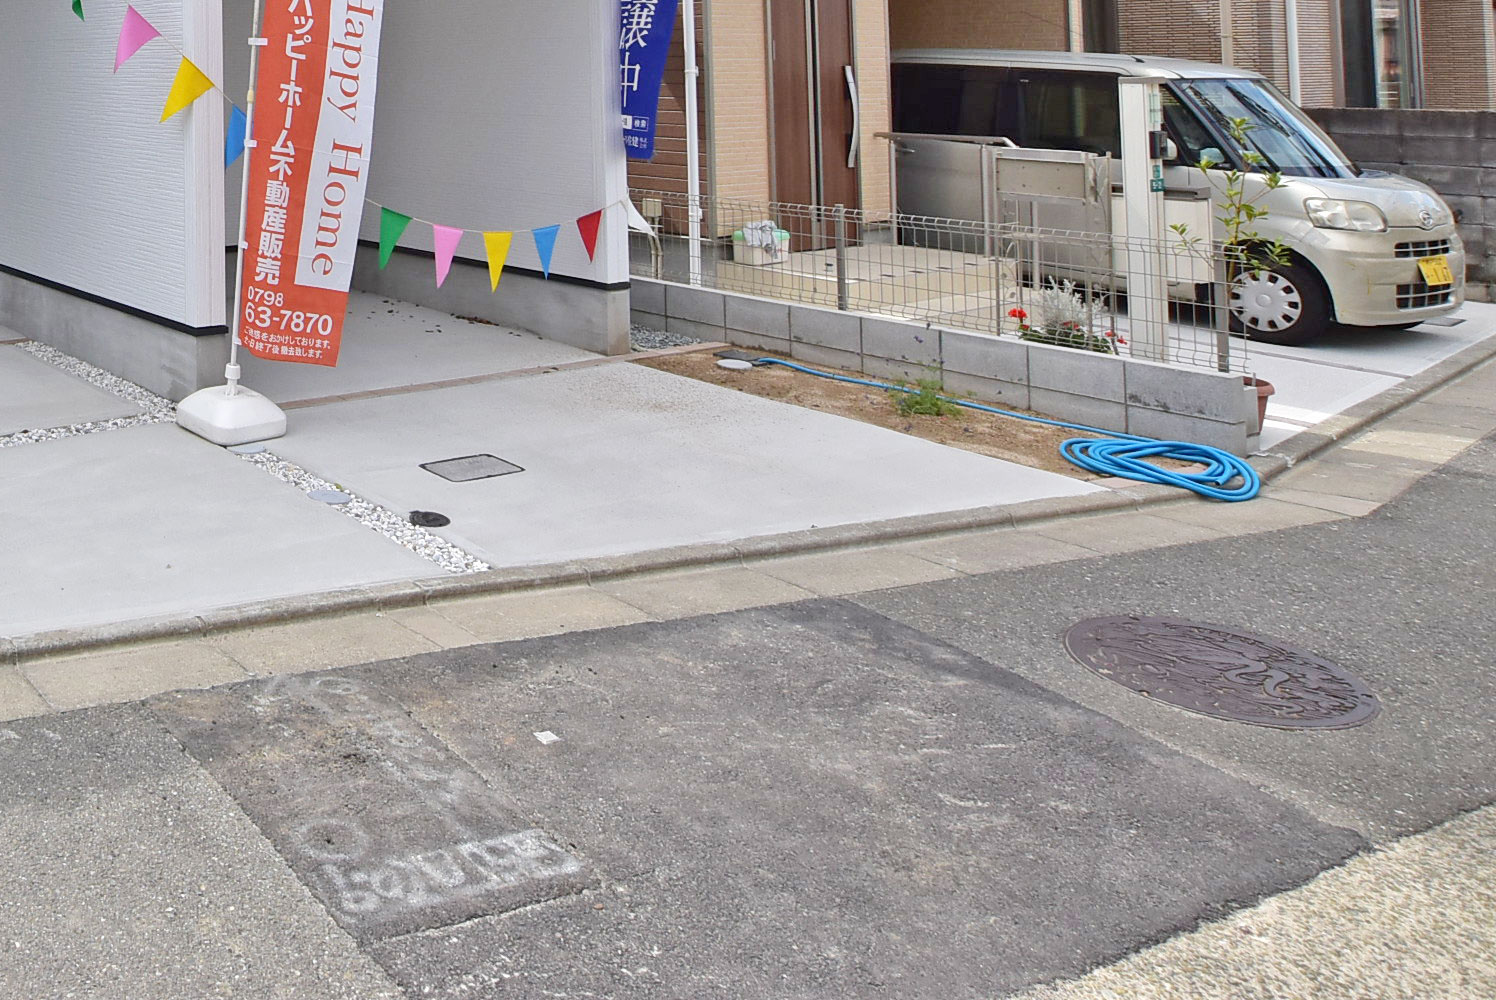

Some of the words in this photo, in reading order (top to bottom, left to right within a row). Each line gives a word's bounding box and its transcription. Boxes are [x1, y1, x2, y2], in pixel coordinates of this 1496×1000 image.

[310, 142, 363, 277] Home
[247, 285, 284, 307] 0798
[245, 301, 333, 336] 63-7870
